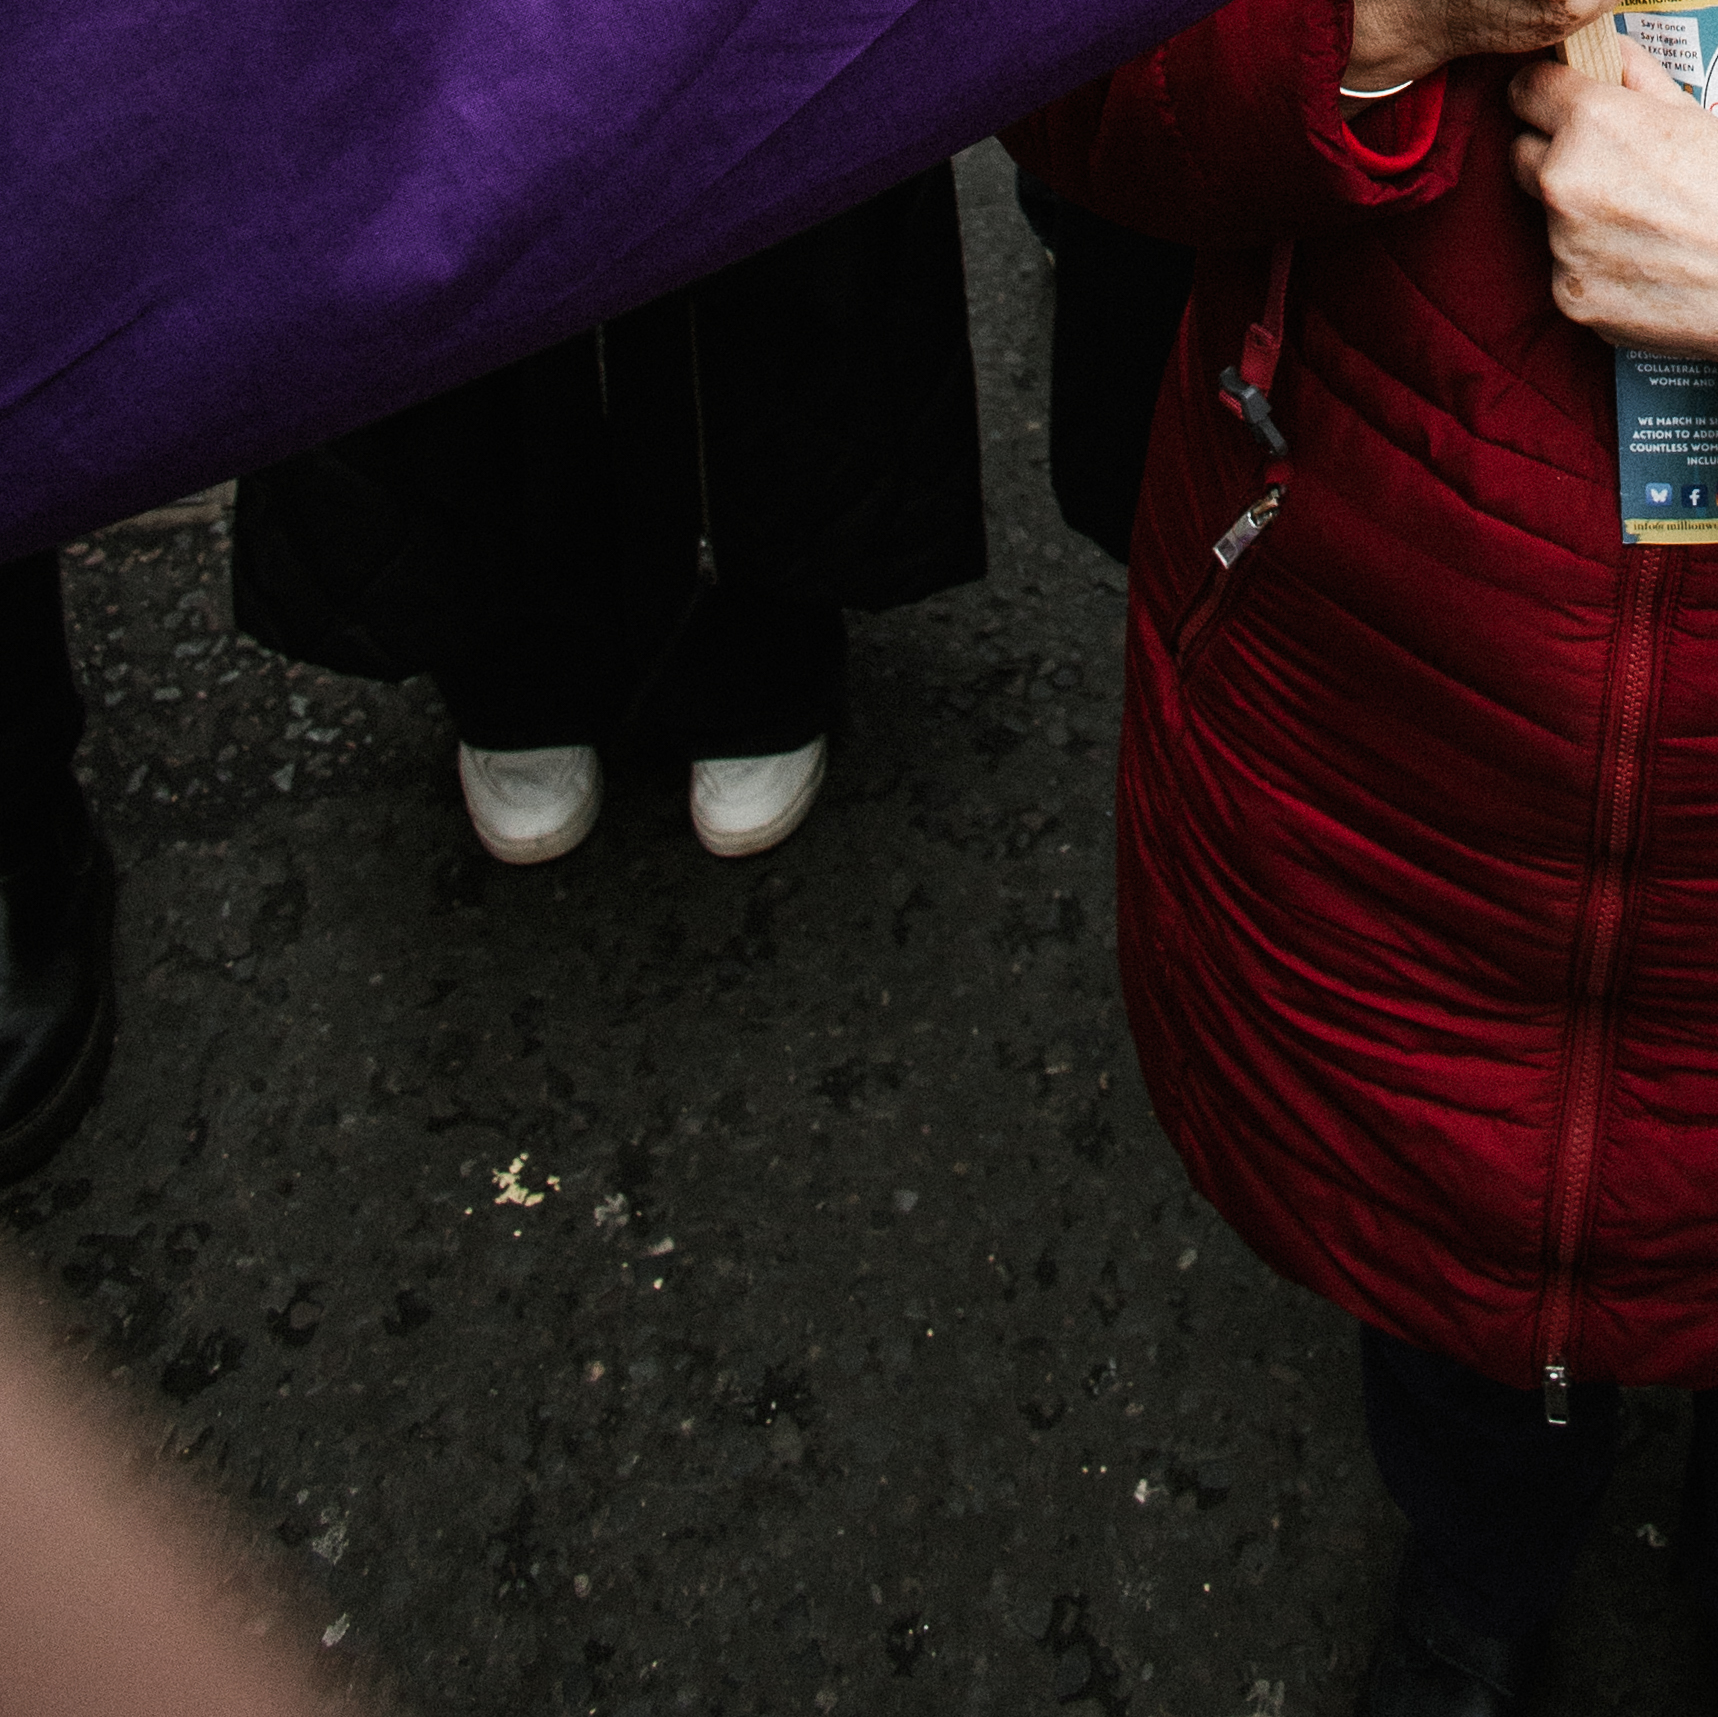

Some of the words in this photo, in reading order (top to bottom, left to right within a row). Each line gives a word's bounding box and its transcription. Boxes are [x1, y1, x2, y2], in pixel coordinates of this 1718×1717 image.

[1641, 19, 1655, 30] Say
[1664, 24, 1686, 32] once
[1641, 32, 1655, 42] Say
[1664, 35, 1687, 46] again
[1648, 46, 1677, 58] EXCUSE
[1680, 49, 1698, 59] FOR
[1674, 61, 1694, 72] MEN
[1649, 377, 1690, 386] WOMEN
[1693, 378, 1715, 386] AND
[1638, 416, 1654, 426] WE
[1656, 416, 1692, 426] MARCH
[1696, 417, 1706, 425] IN
[1632, 430, 1672, 440] ACTION
[1675, 430, 1690, 439] TO
[1629, 443, 1688, 453] COUNTLESS
